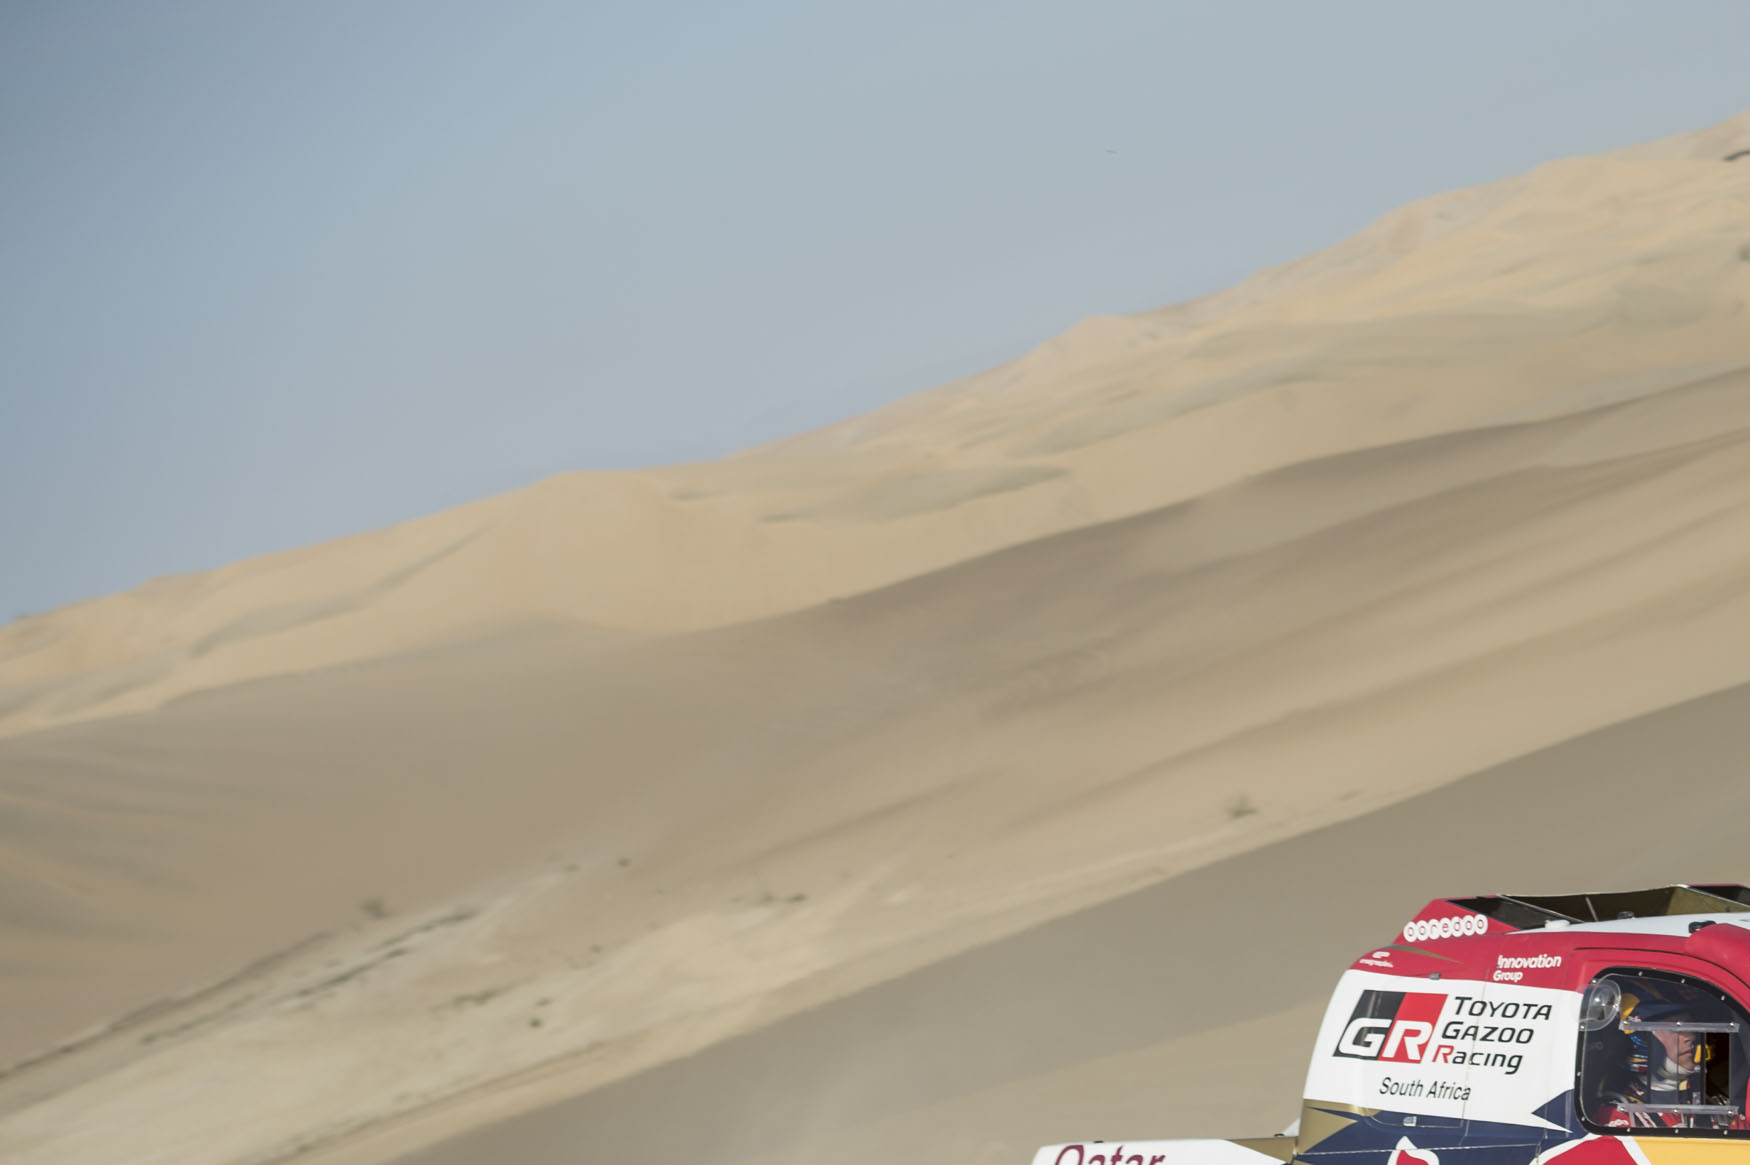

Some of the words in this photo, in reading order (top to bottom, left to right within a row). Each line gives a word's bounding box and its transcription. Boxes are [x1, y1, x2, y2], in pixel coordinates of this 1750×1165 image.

[1403, 914, 1488, 942] ooredoo
[1497, 954, 1562, 969] Innovation
[1493, 970, 1523, 982] Group
[1454, 996, 1552, 1020] TOYOTA
[1339, 1018, 1433, 1061] GR
[1432, 1045, 1523, 1075] Racing
[1379, 1077, 1424, 1097] South
[1426, 1081, 1472, 1101] Africa
